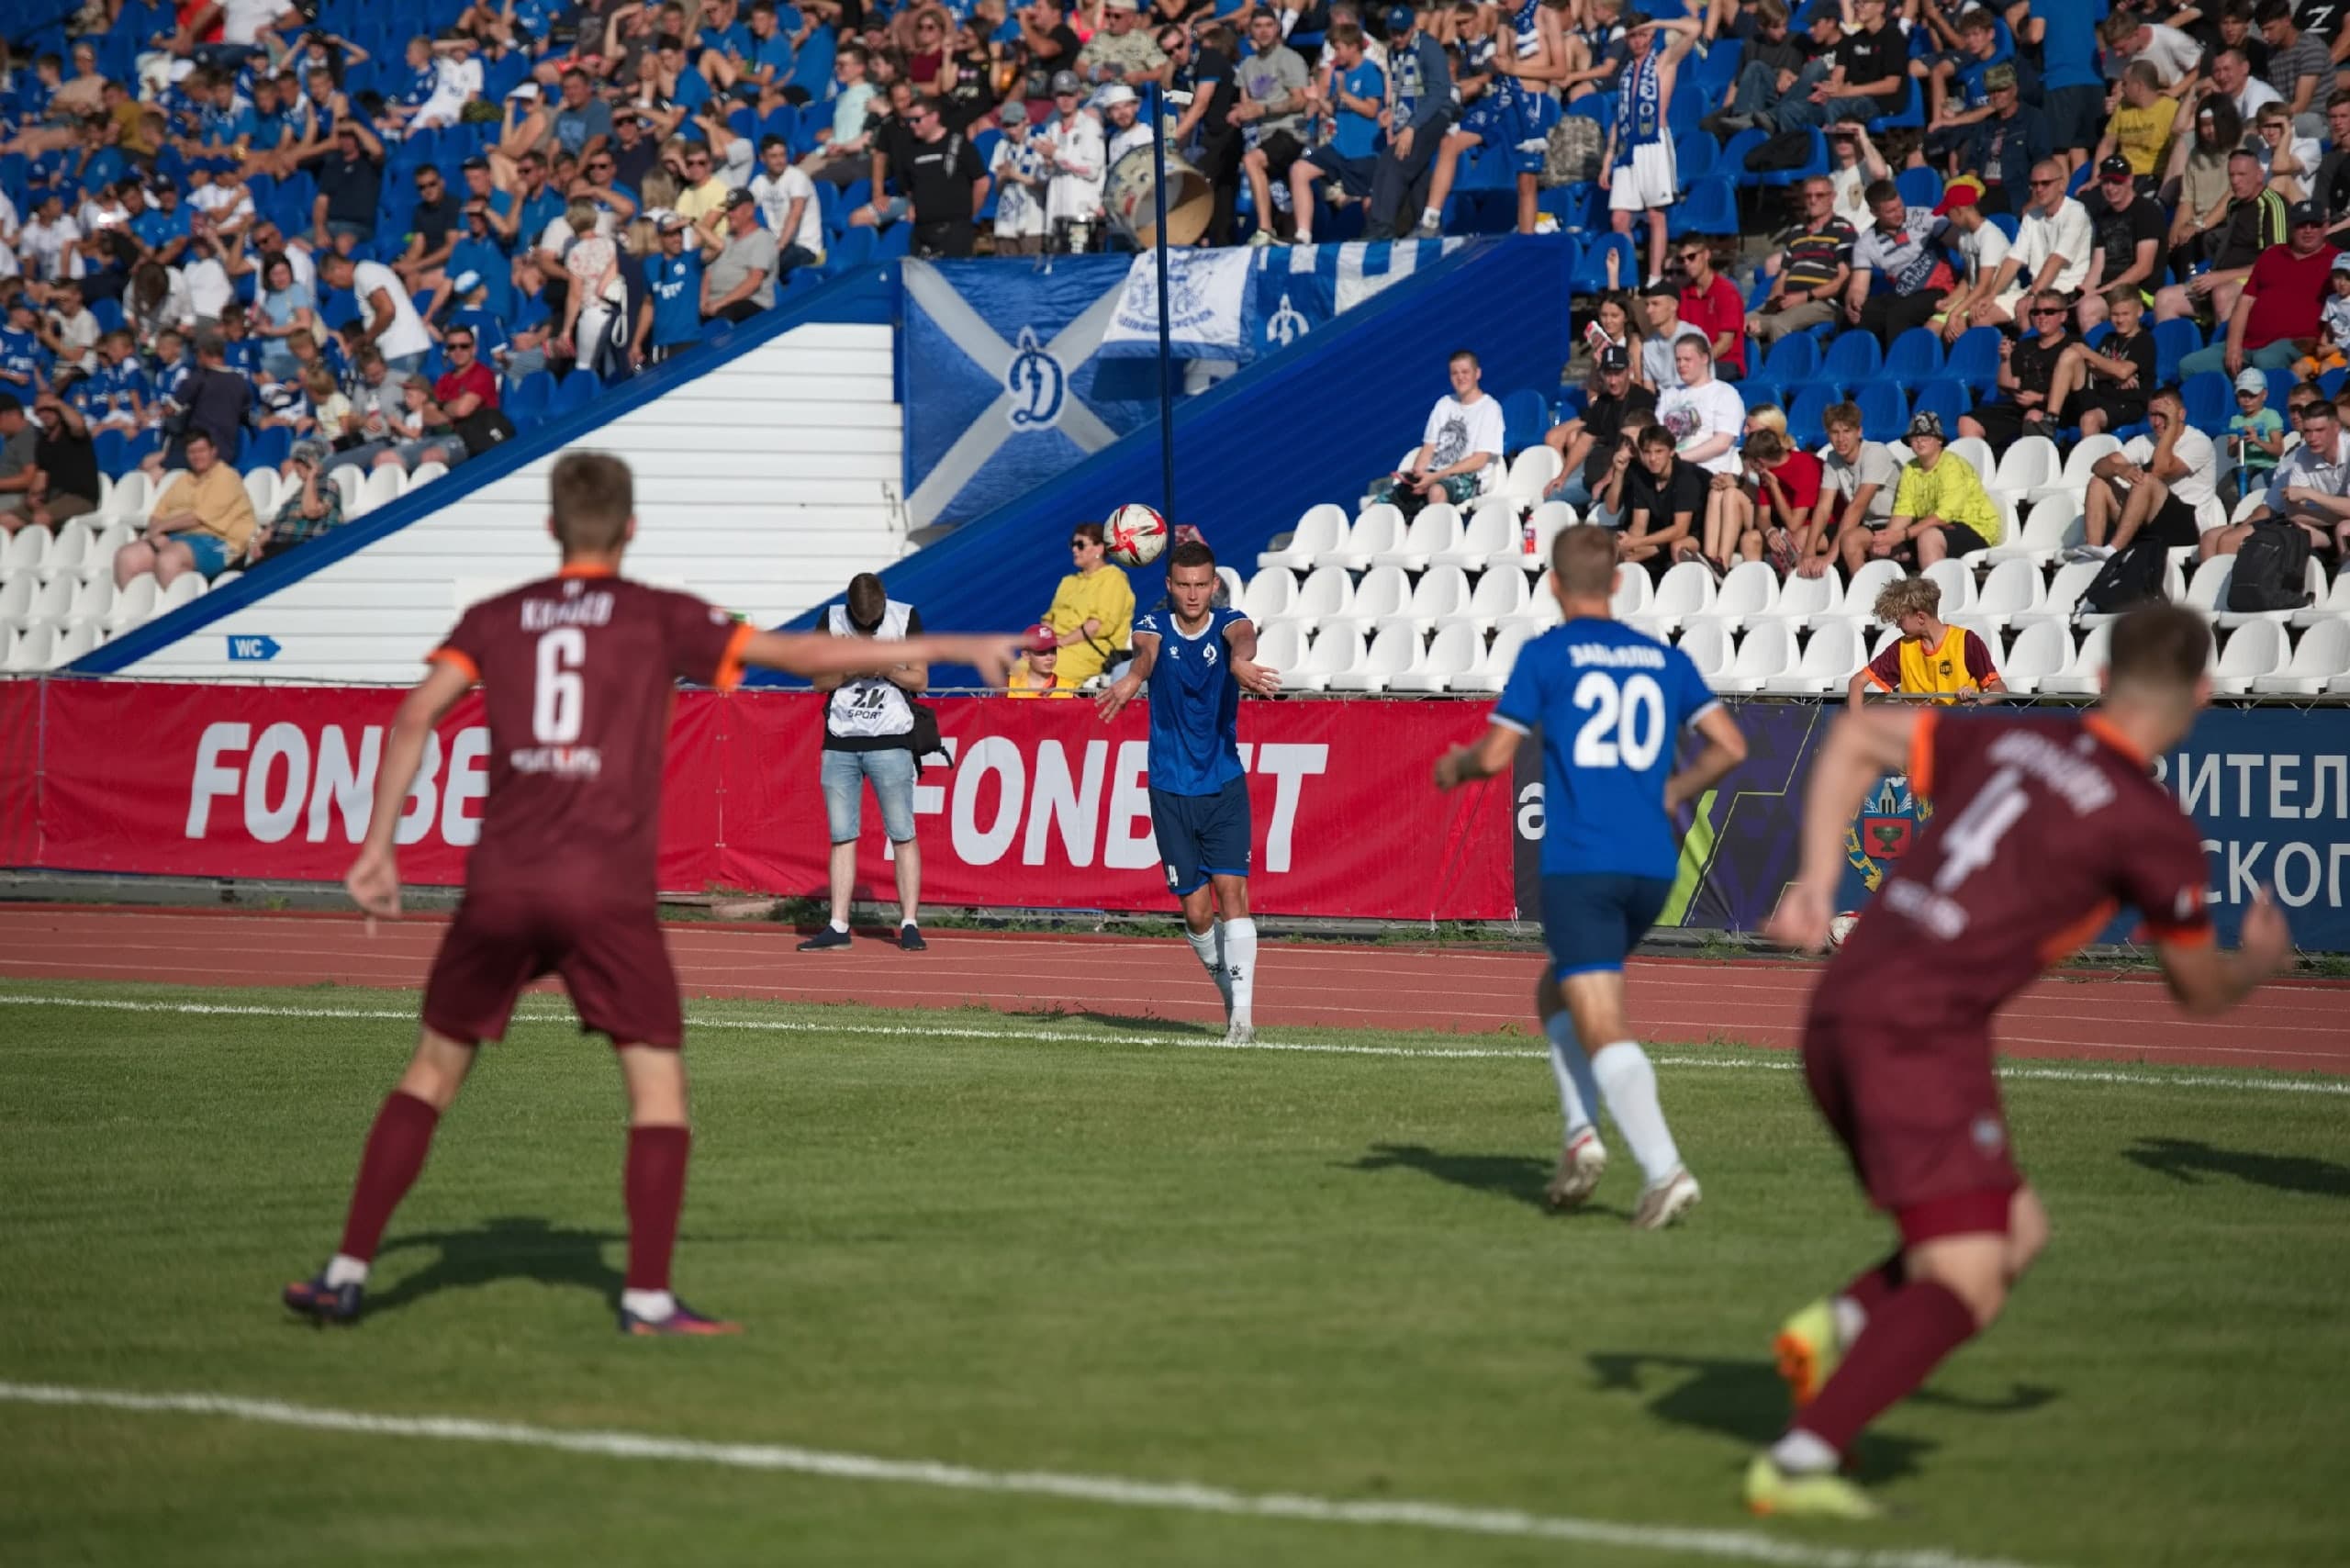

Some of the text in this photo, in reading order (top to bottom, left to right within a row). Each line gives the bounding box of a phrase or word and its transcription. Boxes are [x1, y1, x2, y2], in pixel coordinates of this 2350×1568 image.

[2305, 5, 2334, 33] Z
[235, 638, 263, 657] WC
[533, 627, 586, 745] 6
[1572, 670, 1666, 771] 20
[185, 721, 492, 846] FONBE
[885, 735, 1329, 873] FONBT
[1932, 764, 2030, 896] 4
